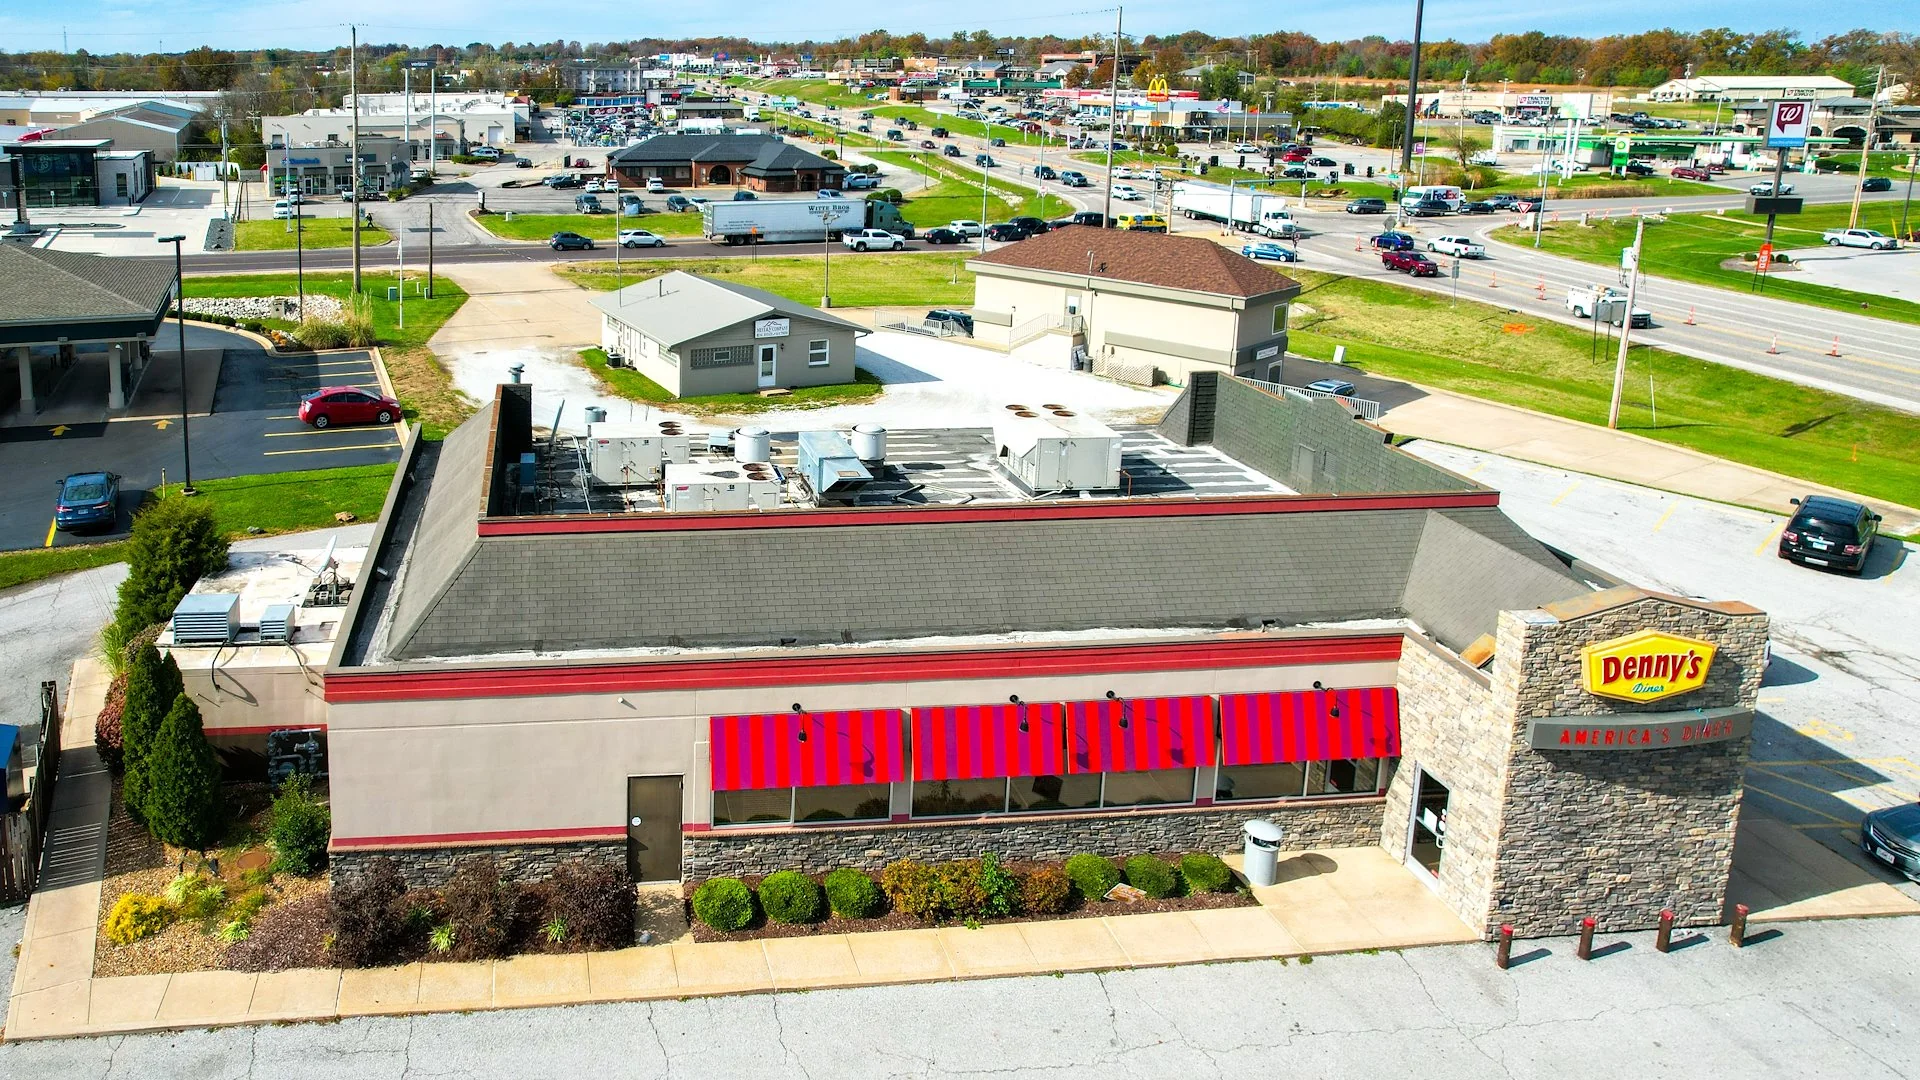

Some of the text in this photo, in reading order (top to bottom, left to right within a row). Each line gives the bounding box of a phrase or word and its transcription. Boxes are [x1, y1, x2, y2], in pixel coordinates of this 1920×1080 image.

[1433, 190, 1457, 200] FedEx
[1602, 650, 1703, 684] Denny's
[1631, 683, 1665, 694] Diner
[1559, 719, 1734, 745] AMERICA'S DINER
